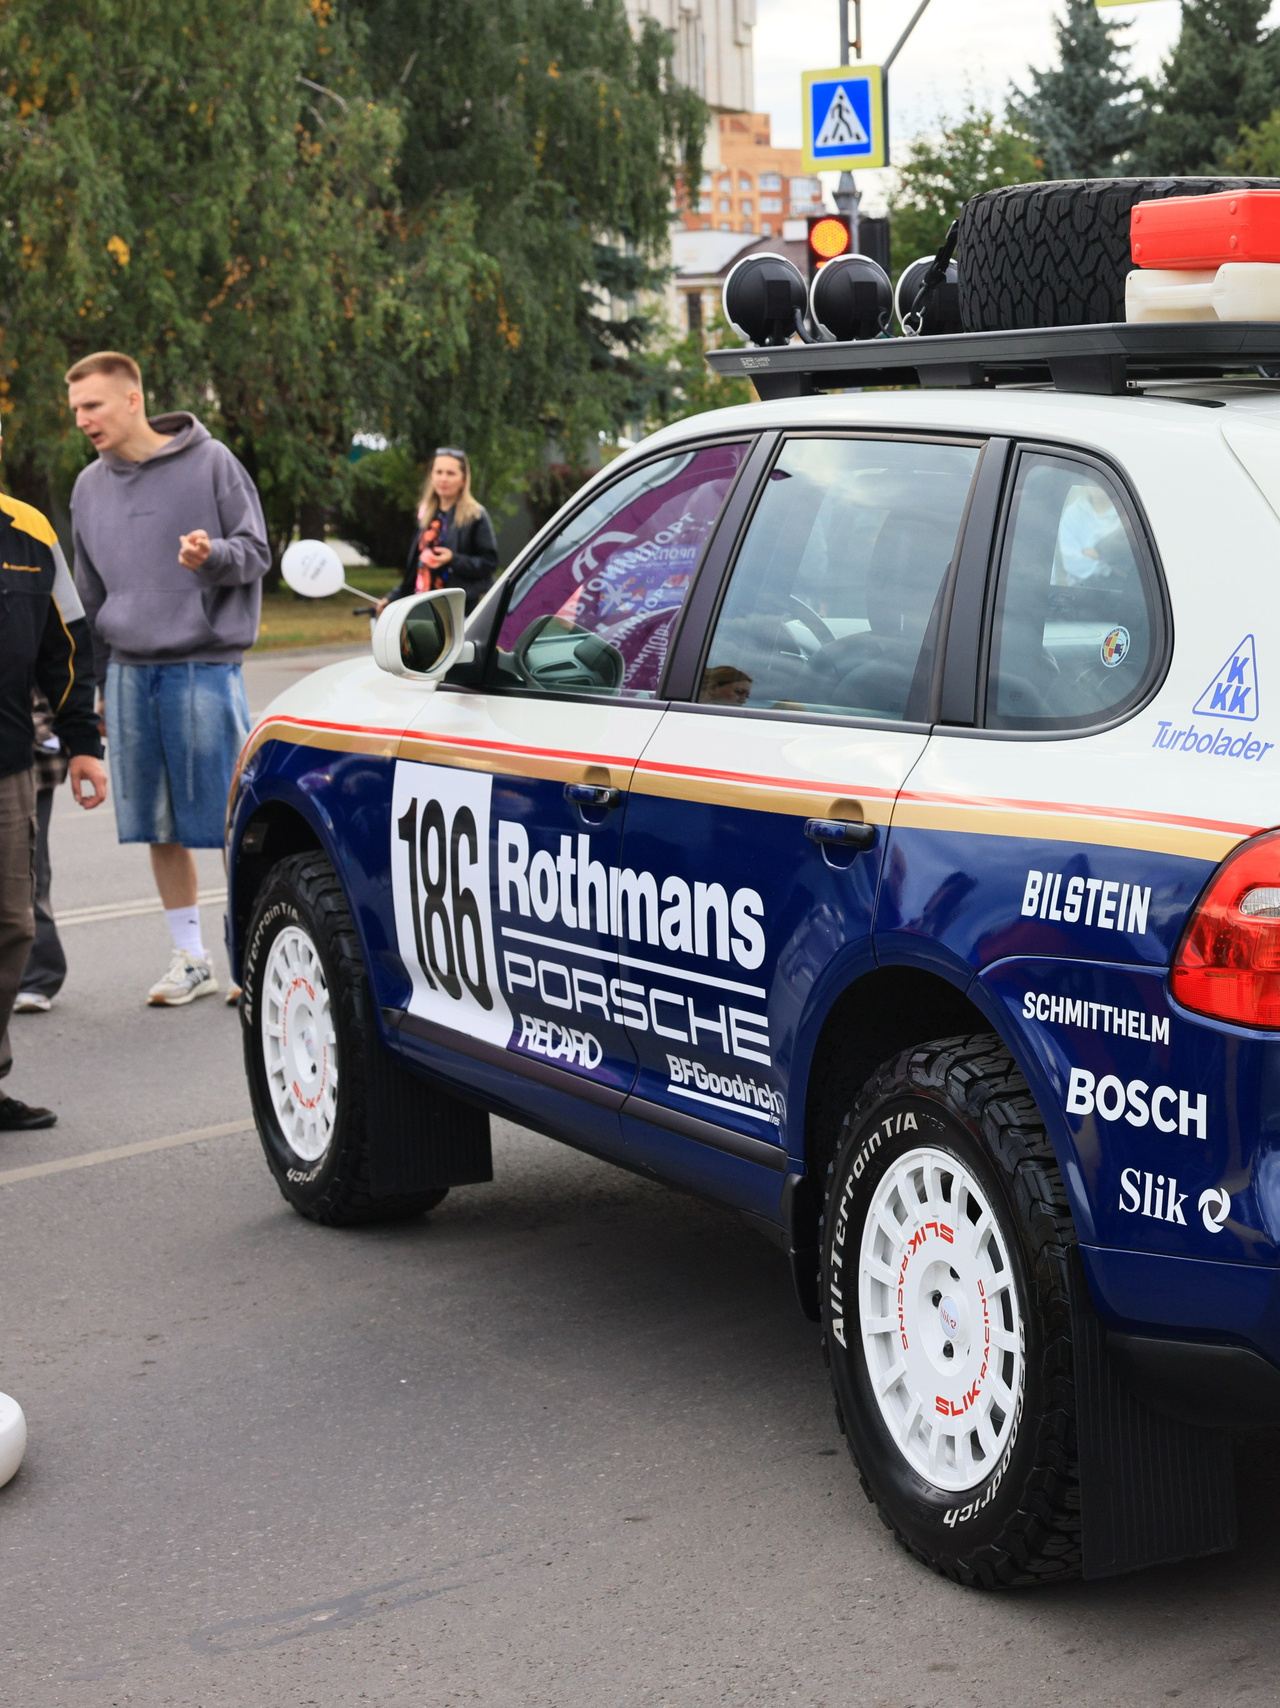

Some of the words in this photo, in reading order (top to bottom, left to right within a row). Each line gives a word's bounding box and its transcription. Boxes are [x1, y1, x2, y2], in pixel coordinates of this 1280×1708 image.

[1208, 683, 1249, 714] KK
[1226, 655, 1251, 685] K
[1150, 720, 1275, 763] Turbolader
[397, 796, 494, 1012] 186
[498, 820, 766, 970] Rothmans
[1021, 870, 1153, 935] BILSTEIN
[503, 950, 772, 1067] PORSCHE
[1022, 990, 1171, 1046] SCHMITTHELM
[517, 1013, 603, 1070] RECARO
[665, 1054, 780, 1114] BFGoodrich
[1065, 1066, 1208, 1140] BOSCH
[1118, 1167, 1189, 1226] Slik
[831, 1130, 882, 1350] All-Terrain
[881, 1111, 919, 1140] T/A
[935, 1378, 981, 1417] SLIK
